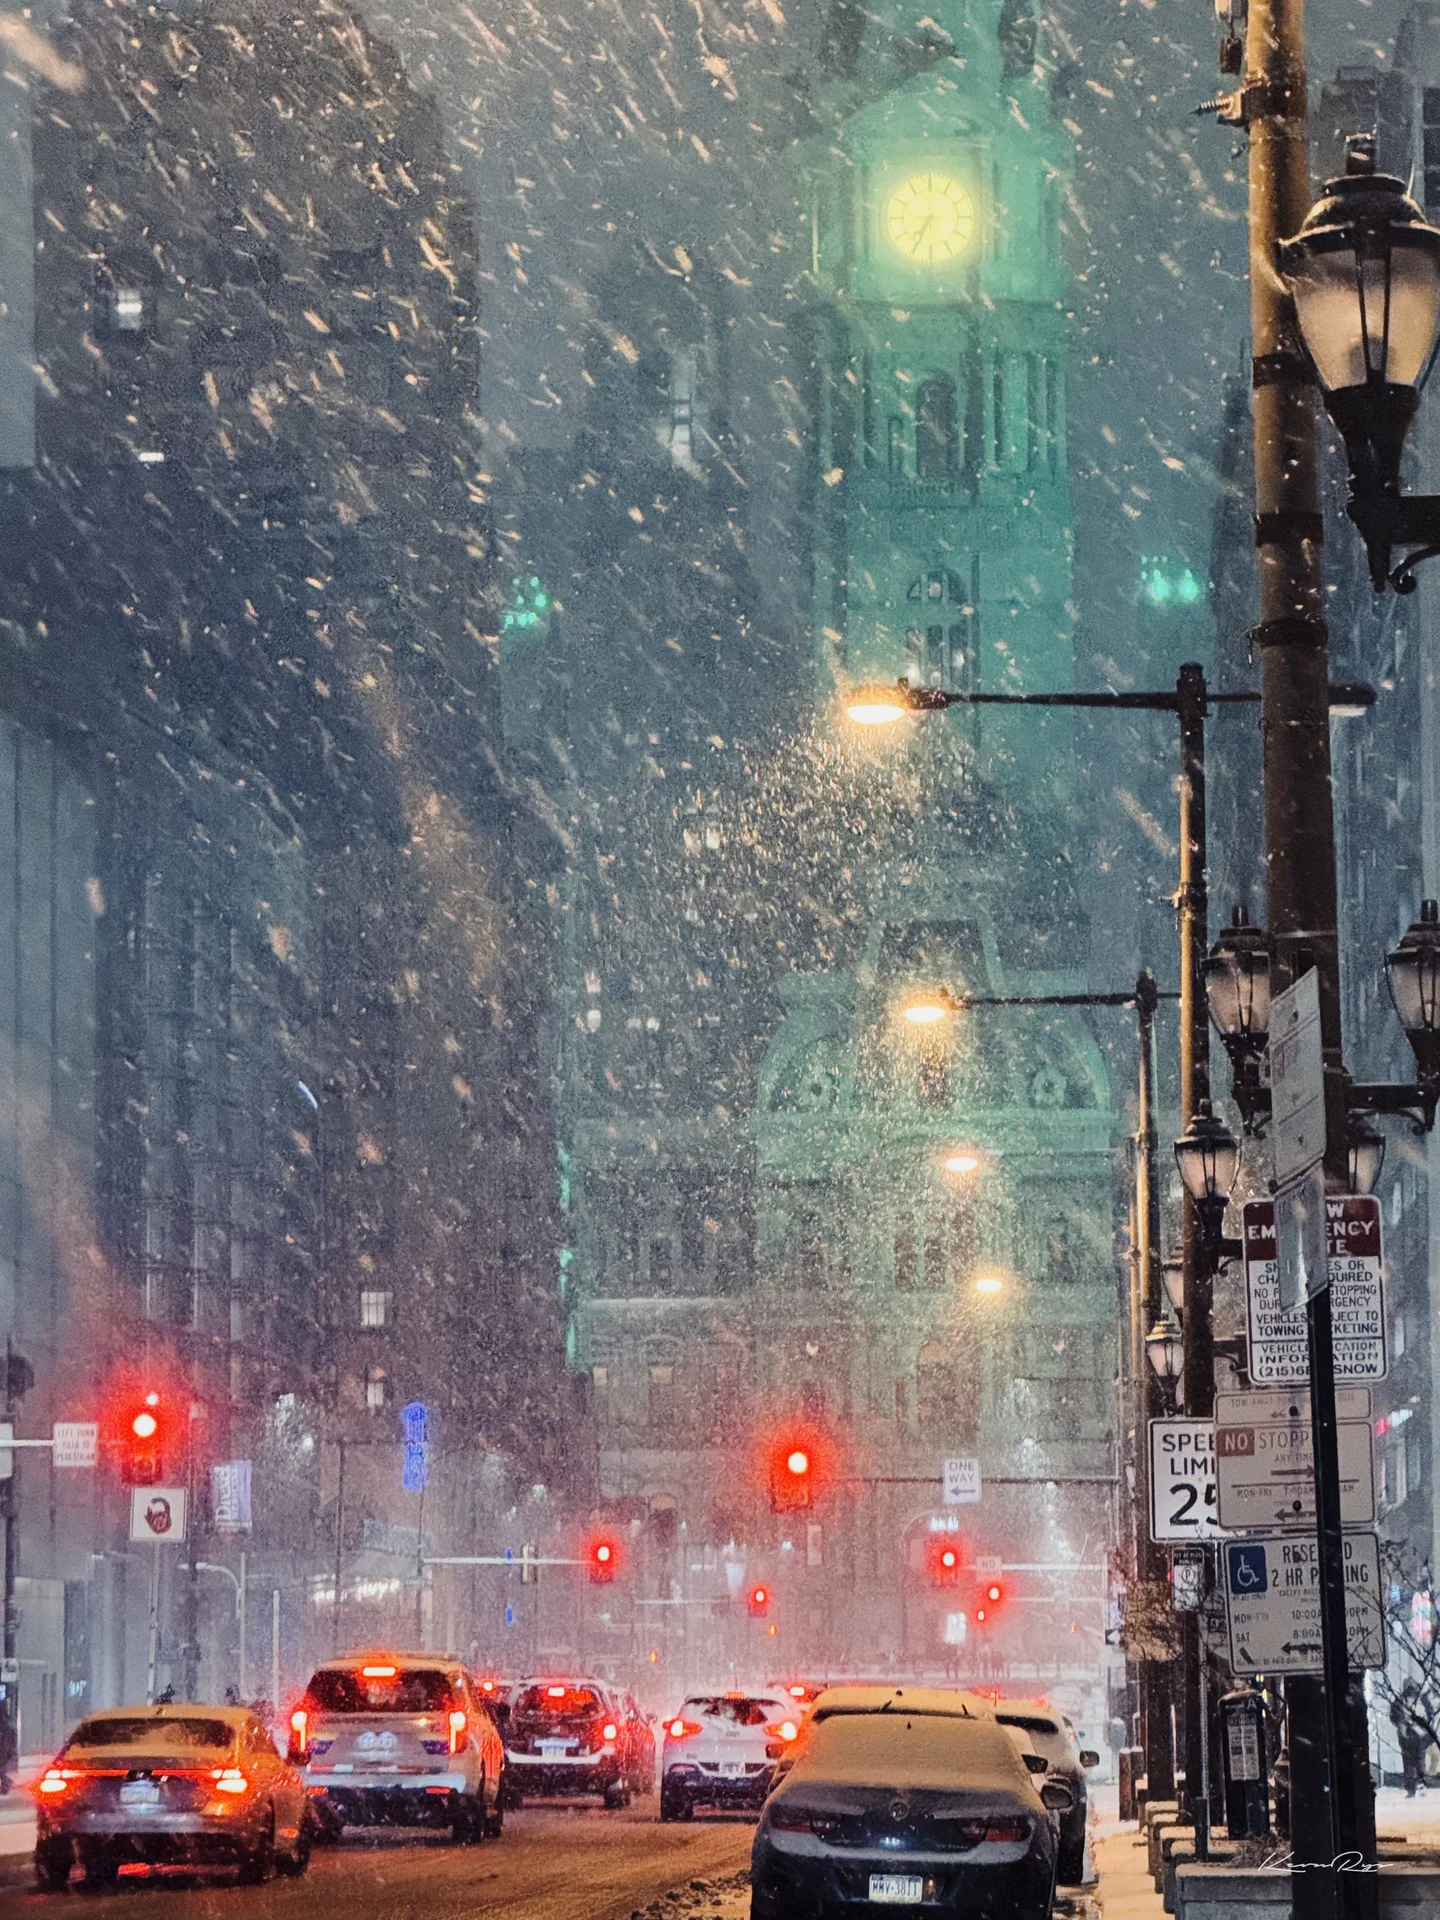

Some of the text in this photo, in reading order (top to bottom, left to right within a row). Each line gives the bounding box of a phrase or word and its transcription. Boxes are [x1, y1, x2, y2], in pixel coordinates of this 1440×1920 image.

[1248, 1220, 1374, 1239] EMENCY
[1348, 1260, 1365, 1270] OR
[1328, 1271, 1373, 1283] QUIRED
[1254, 1288, 1268, 1298] NO
[1330, 1297, 1371, 1308] RGENCY
[1256, 1311, 1379, 1324] VEHICLES BJECT TO
[1258, 1323, 1378, 1337] TOWING KETING
[1261, 1341, 1377, 1353] VEHICLE CATION
[1260, 1352, 1379, 1364] INFORATION
[1225, 1431, 1309, 1451] NO STOPP
[1274, 1454, 1291, 1463] ANY
[949, 1462, 975, 1471] ONE
[1170, 1457, 1215, 1475] LIMI
[949, 1473, 975, 1483] WAY
[1283, 1542, 1352, 1563] RESED
[1271, 1564, 1368, 1587] 2 HR PING
[1292, 1609, 1322, 1620] 10:00A
[1235, 1632, 1250, 1643] SAT
[1293, 1628, 1321, 1639] 8:00A
